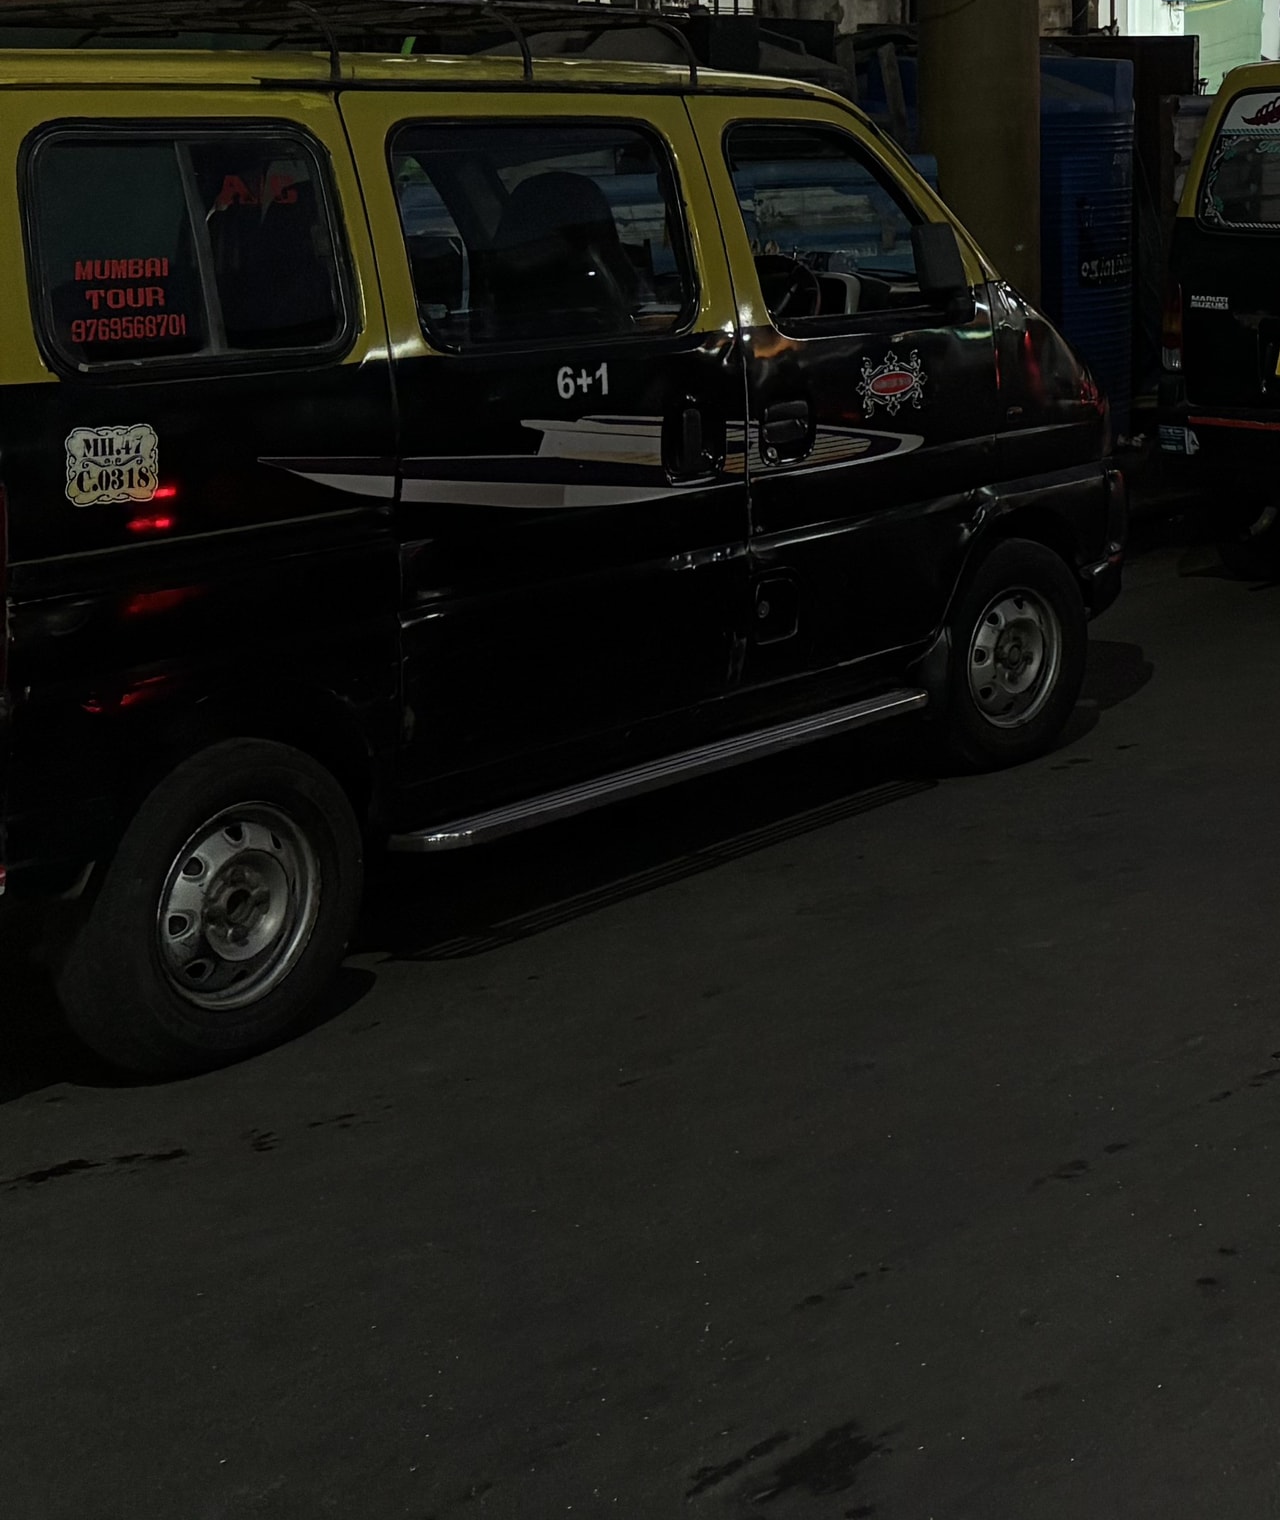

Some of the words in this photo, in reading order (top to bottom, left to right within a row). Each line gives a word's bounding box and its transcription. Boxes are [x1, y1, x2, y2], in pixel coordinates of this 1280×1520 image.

[74, 257, 169, 282] MUMBAI
[84, 286, 165, 312] TOUR
[71, 313, 187, 344] 9769568701
[556, 361, 609, 400] 6+1
